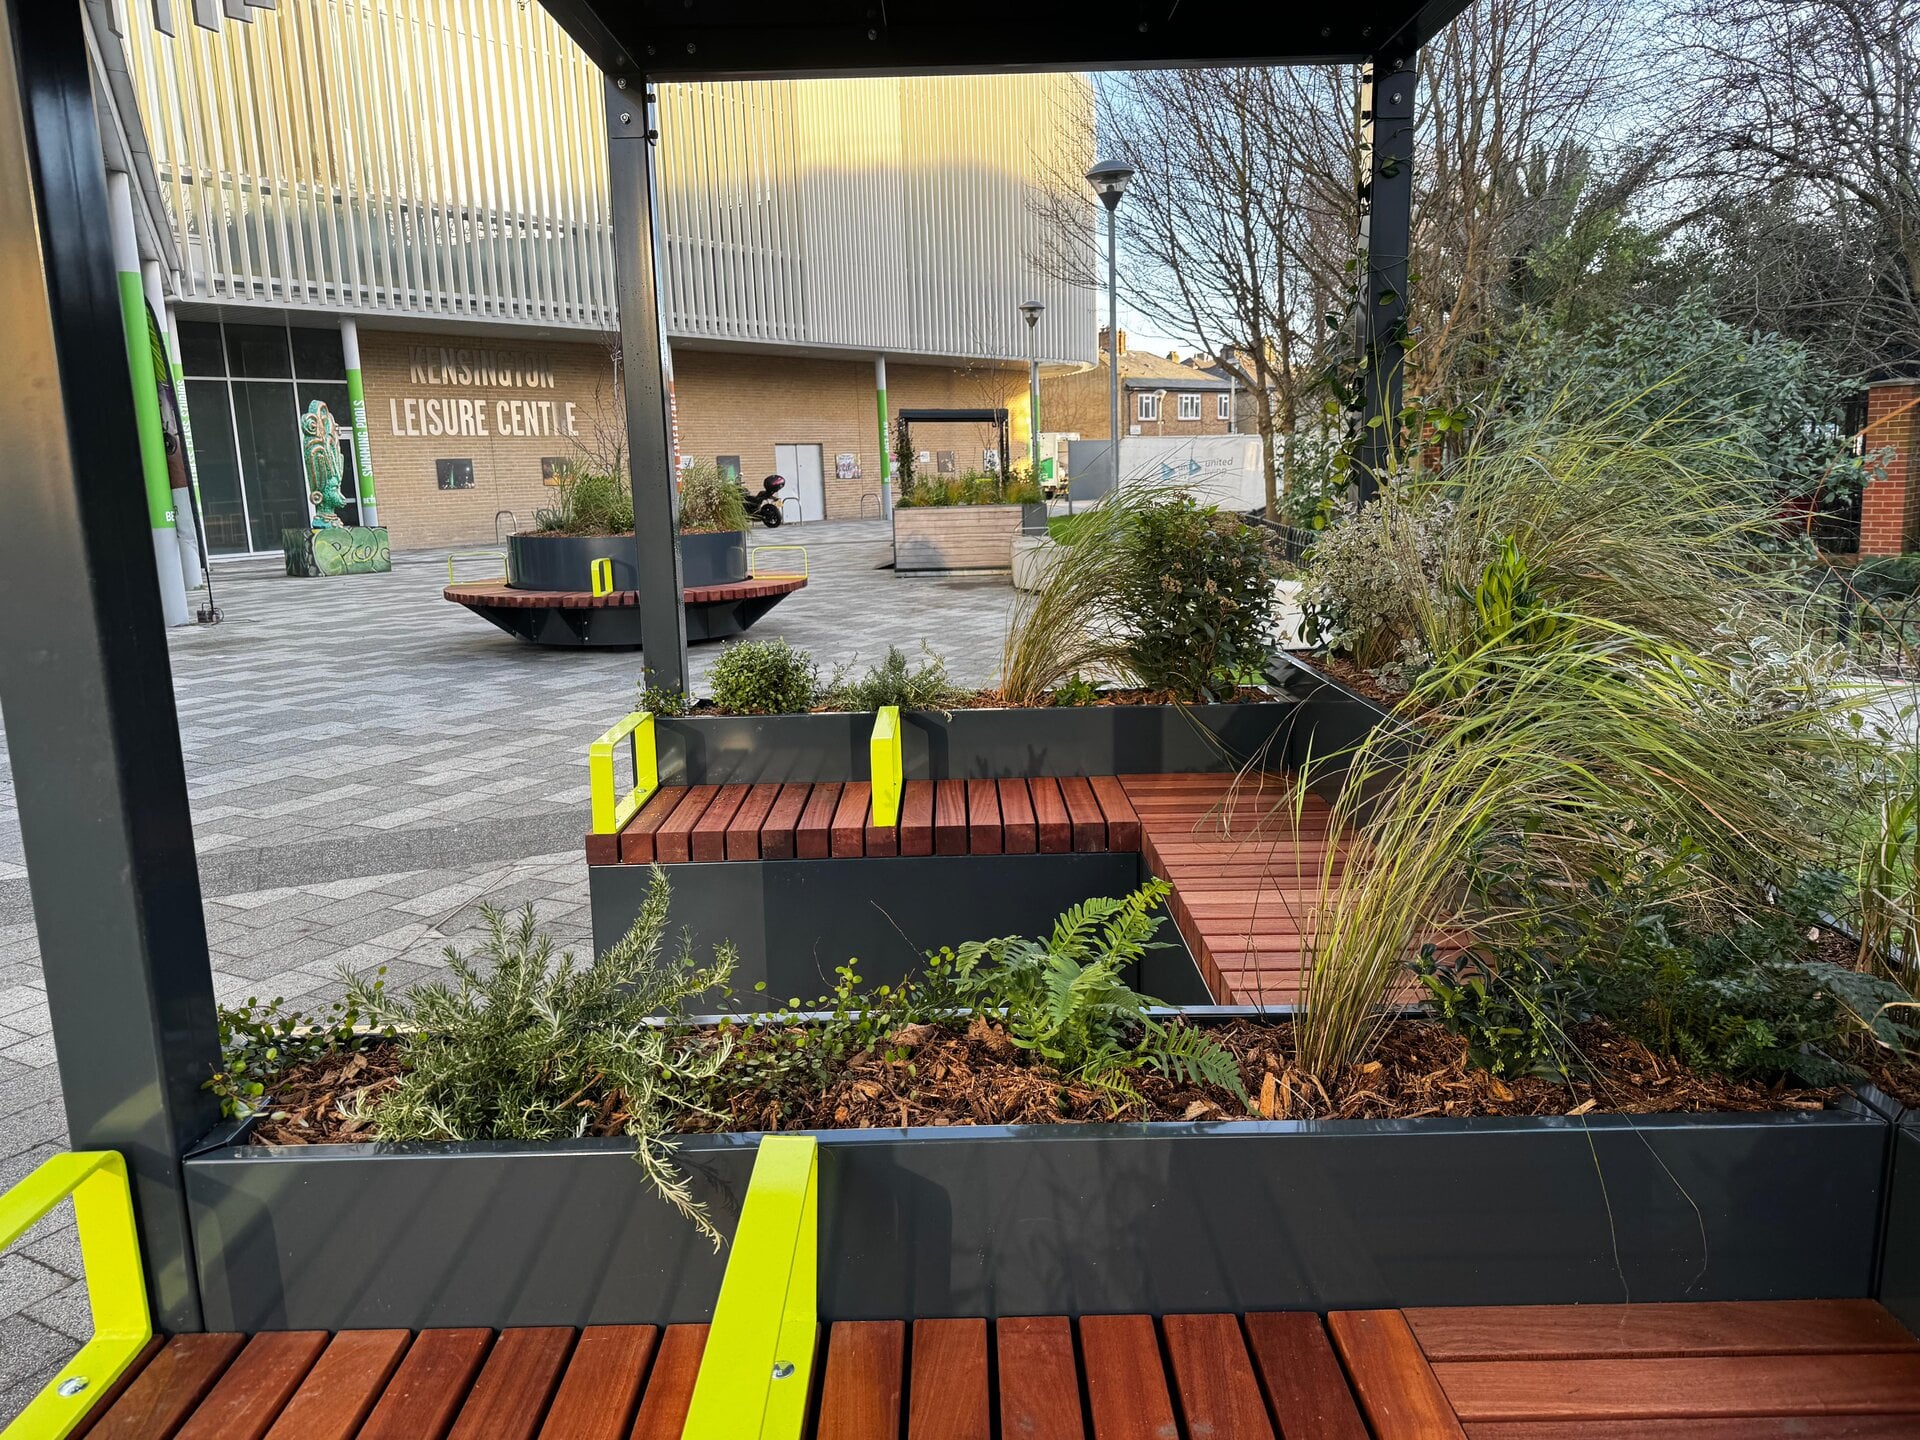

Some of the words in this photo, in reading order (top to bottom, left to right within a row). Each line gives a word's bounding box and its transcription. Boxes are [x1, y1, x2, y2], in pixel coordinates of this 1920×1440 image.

[408, 346, 555, 388] KENSINGTON
[354, 400, 367, 428] POOLS
[390, 398, 490, 436] LEISURE
[357, 431, 373, 477] SWIMMING
[1205, 456, 1234, 467] united
